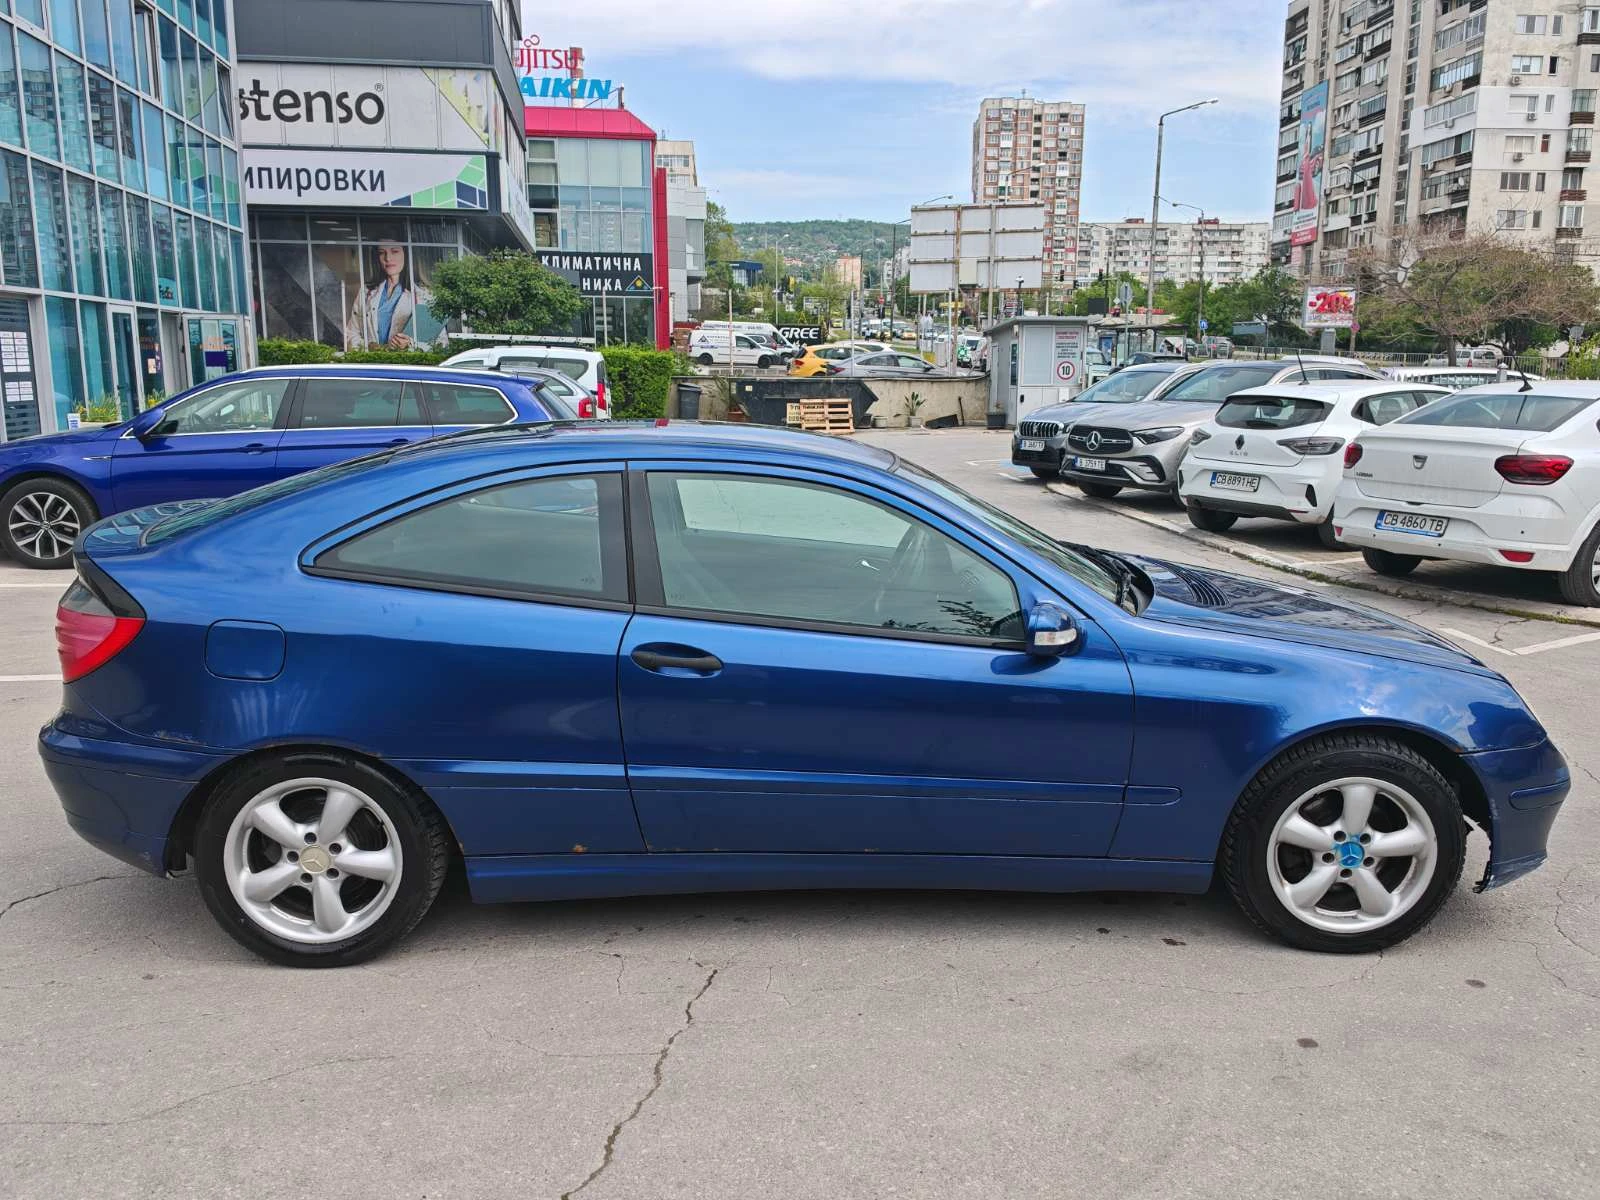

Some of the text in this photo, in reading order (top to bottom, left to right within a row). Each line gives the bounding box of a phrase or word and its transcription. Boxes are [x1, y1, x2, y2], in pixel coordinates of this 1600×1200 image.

[541, 255, 642, 271] КЛИМАТИЧНА
[582, 277, 622, 291] НИКА
[780, 327, 820, 339] GREE
[1061, 365, 1071, 376] 10
[1216, 474, 1227, 485] CB
[1227, 475, 1245, 487] 8891
[1384, 513, 1445, 532] CB 4860 TB
